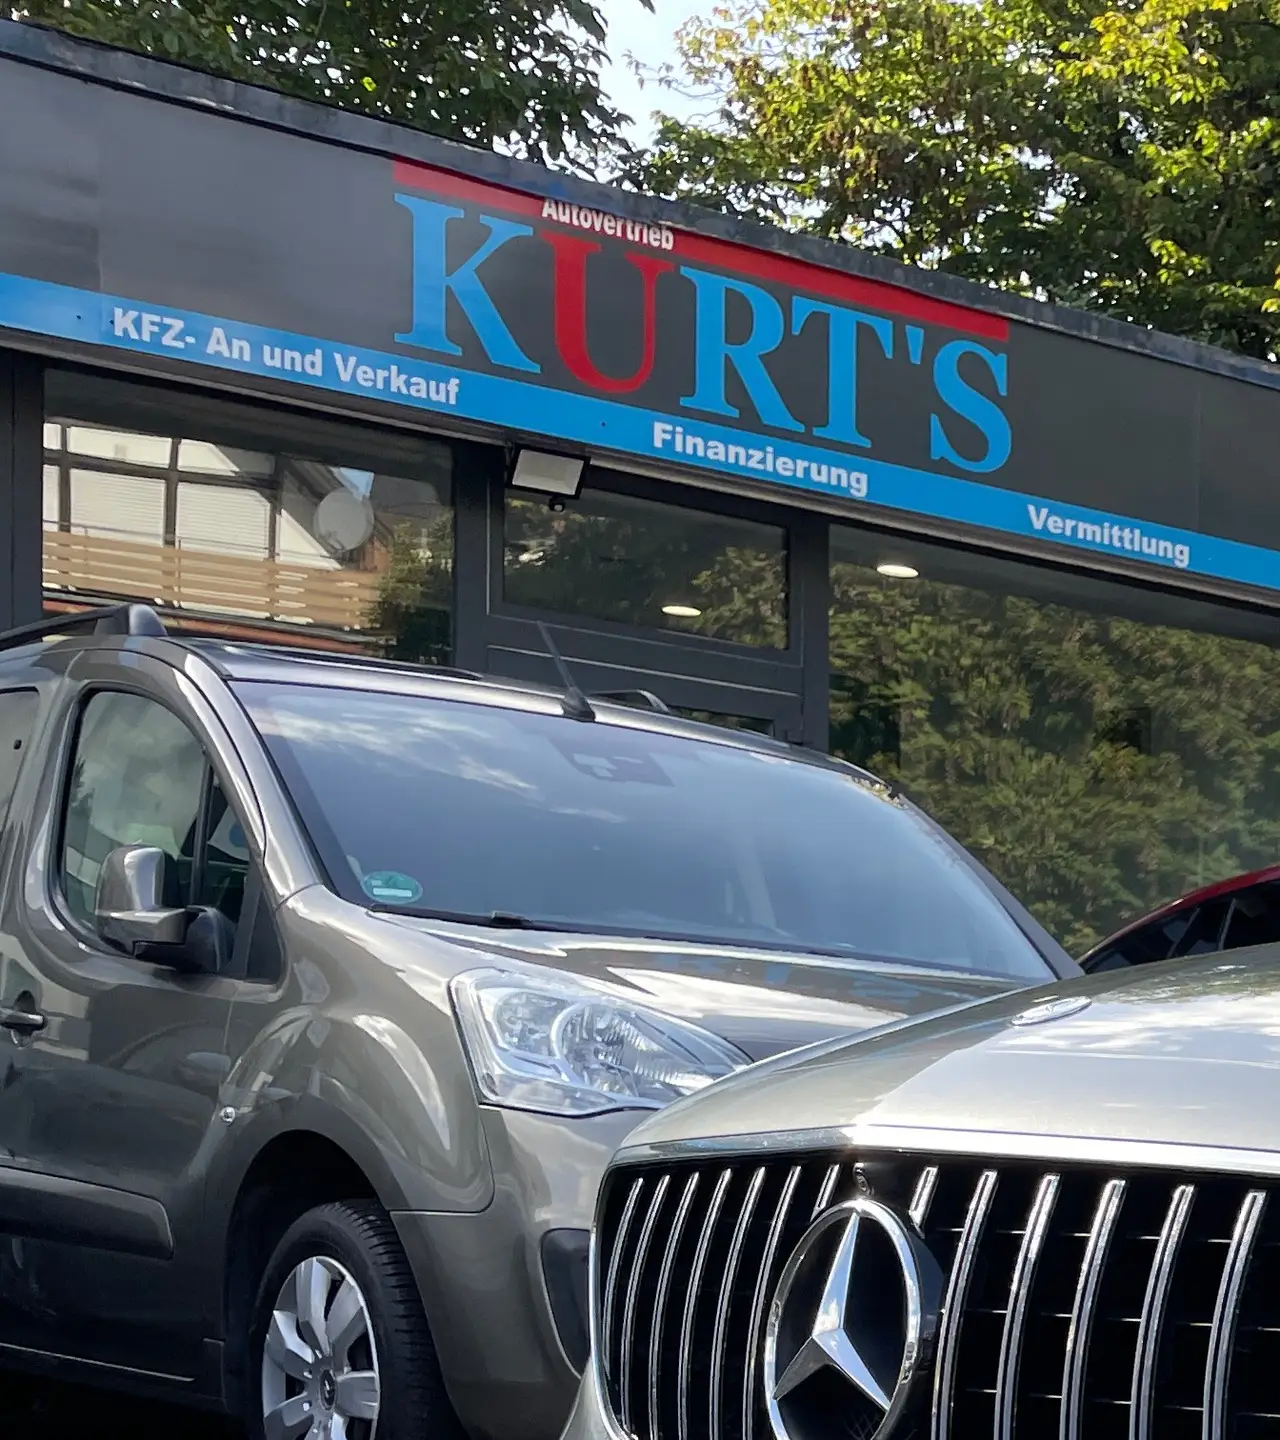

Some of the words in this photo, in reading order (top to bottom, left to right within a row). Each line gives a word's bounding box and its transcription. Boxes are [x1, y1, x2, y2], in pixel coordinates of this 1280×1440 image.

[542, 198, 674, 250] Autovertrieb
[113, 307, 197, 348] KFZ-
[206, 327, 251, 362] An
[263, 345, 323, 378] und
[334, 353, 461, 405] Verkauf
[394, 193, 1012, 472] KURT'S
[652, 422, 869, 498] Finanzierung
[1028, 504, 1190, 568] Vermittlung
